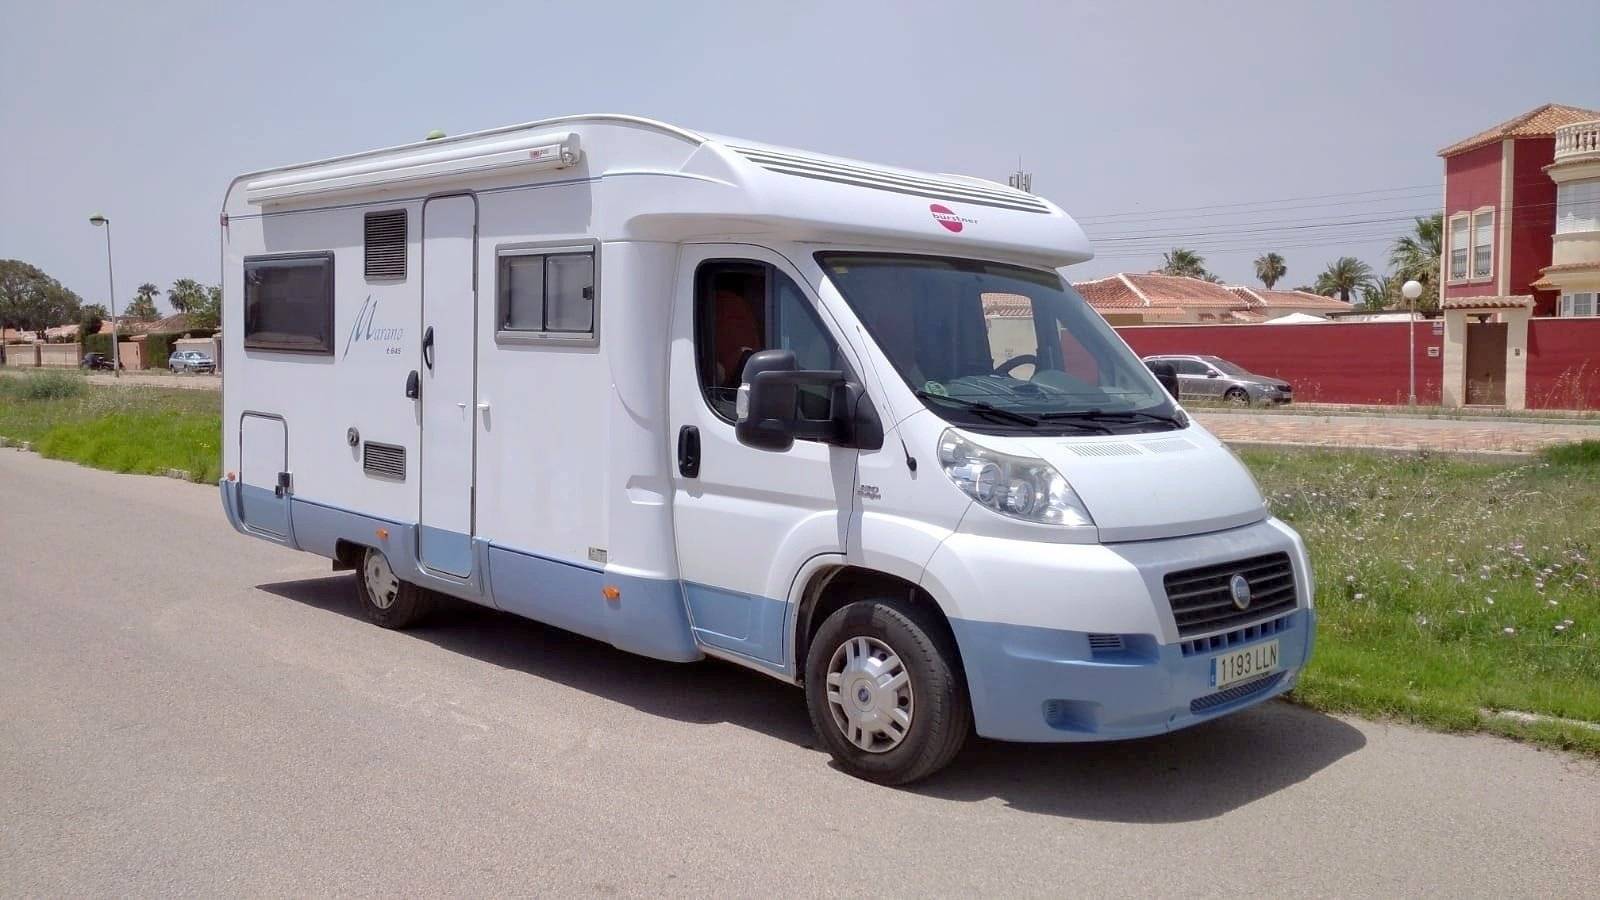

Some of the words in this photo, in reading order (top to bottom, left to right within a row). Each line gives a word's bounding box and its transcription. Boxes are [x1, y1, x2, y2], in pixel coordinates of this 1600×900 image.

[342, 294, 404, 361] Marano
[1222, 652, 1251, 681] 1193
[1255, 643, 1277, 670] LLN
